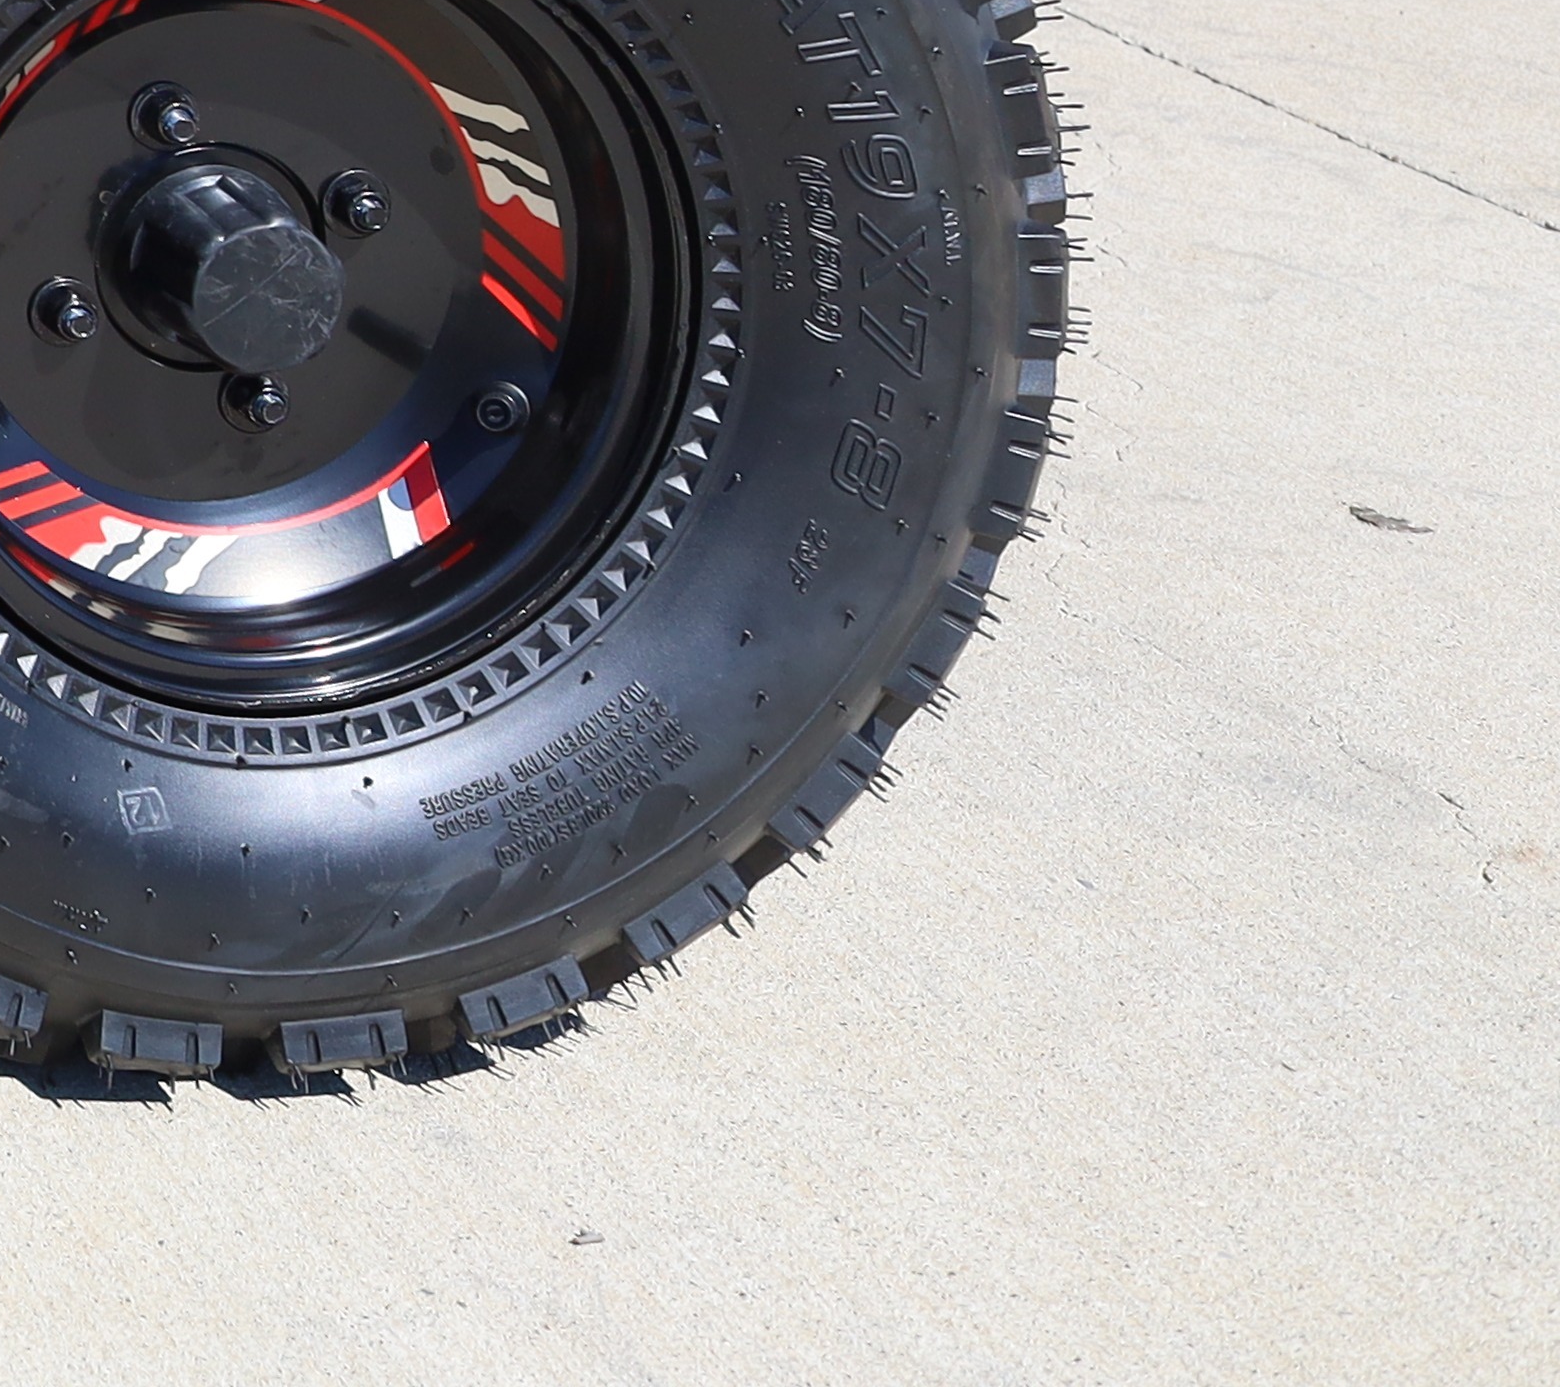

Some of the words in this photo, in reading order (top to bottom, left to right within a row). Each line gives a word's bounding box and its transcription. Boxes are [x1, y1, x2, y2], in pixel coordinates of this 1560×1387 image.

[597, 742, 651, 793] RATING
[661, 732, 702, 772] MAX
[419, 772, 509, 820] PRESSURE
[545, 767, 573, 793] TO
[497, 783, 543, 818] SEAT
[506, 784, 591, 840] TUBELESS
[432, 807, 493, 841] BEADS
